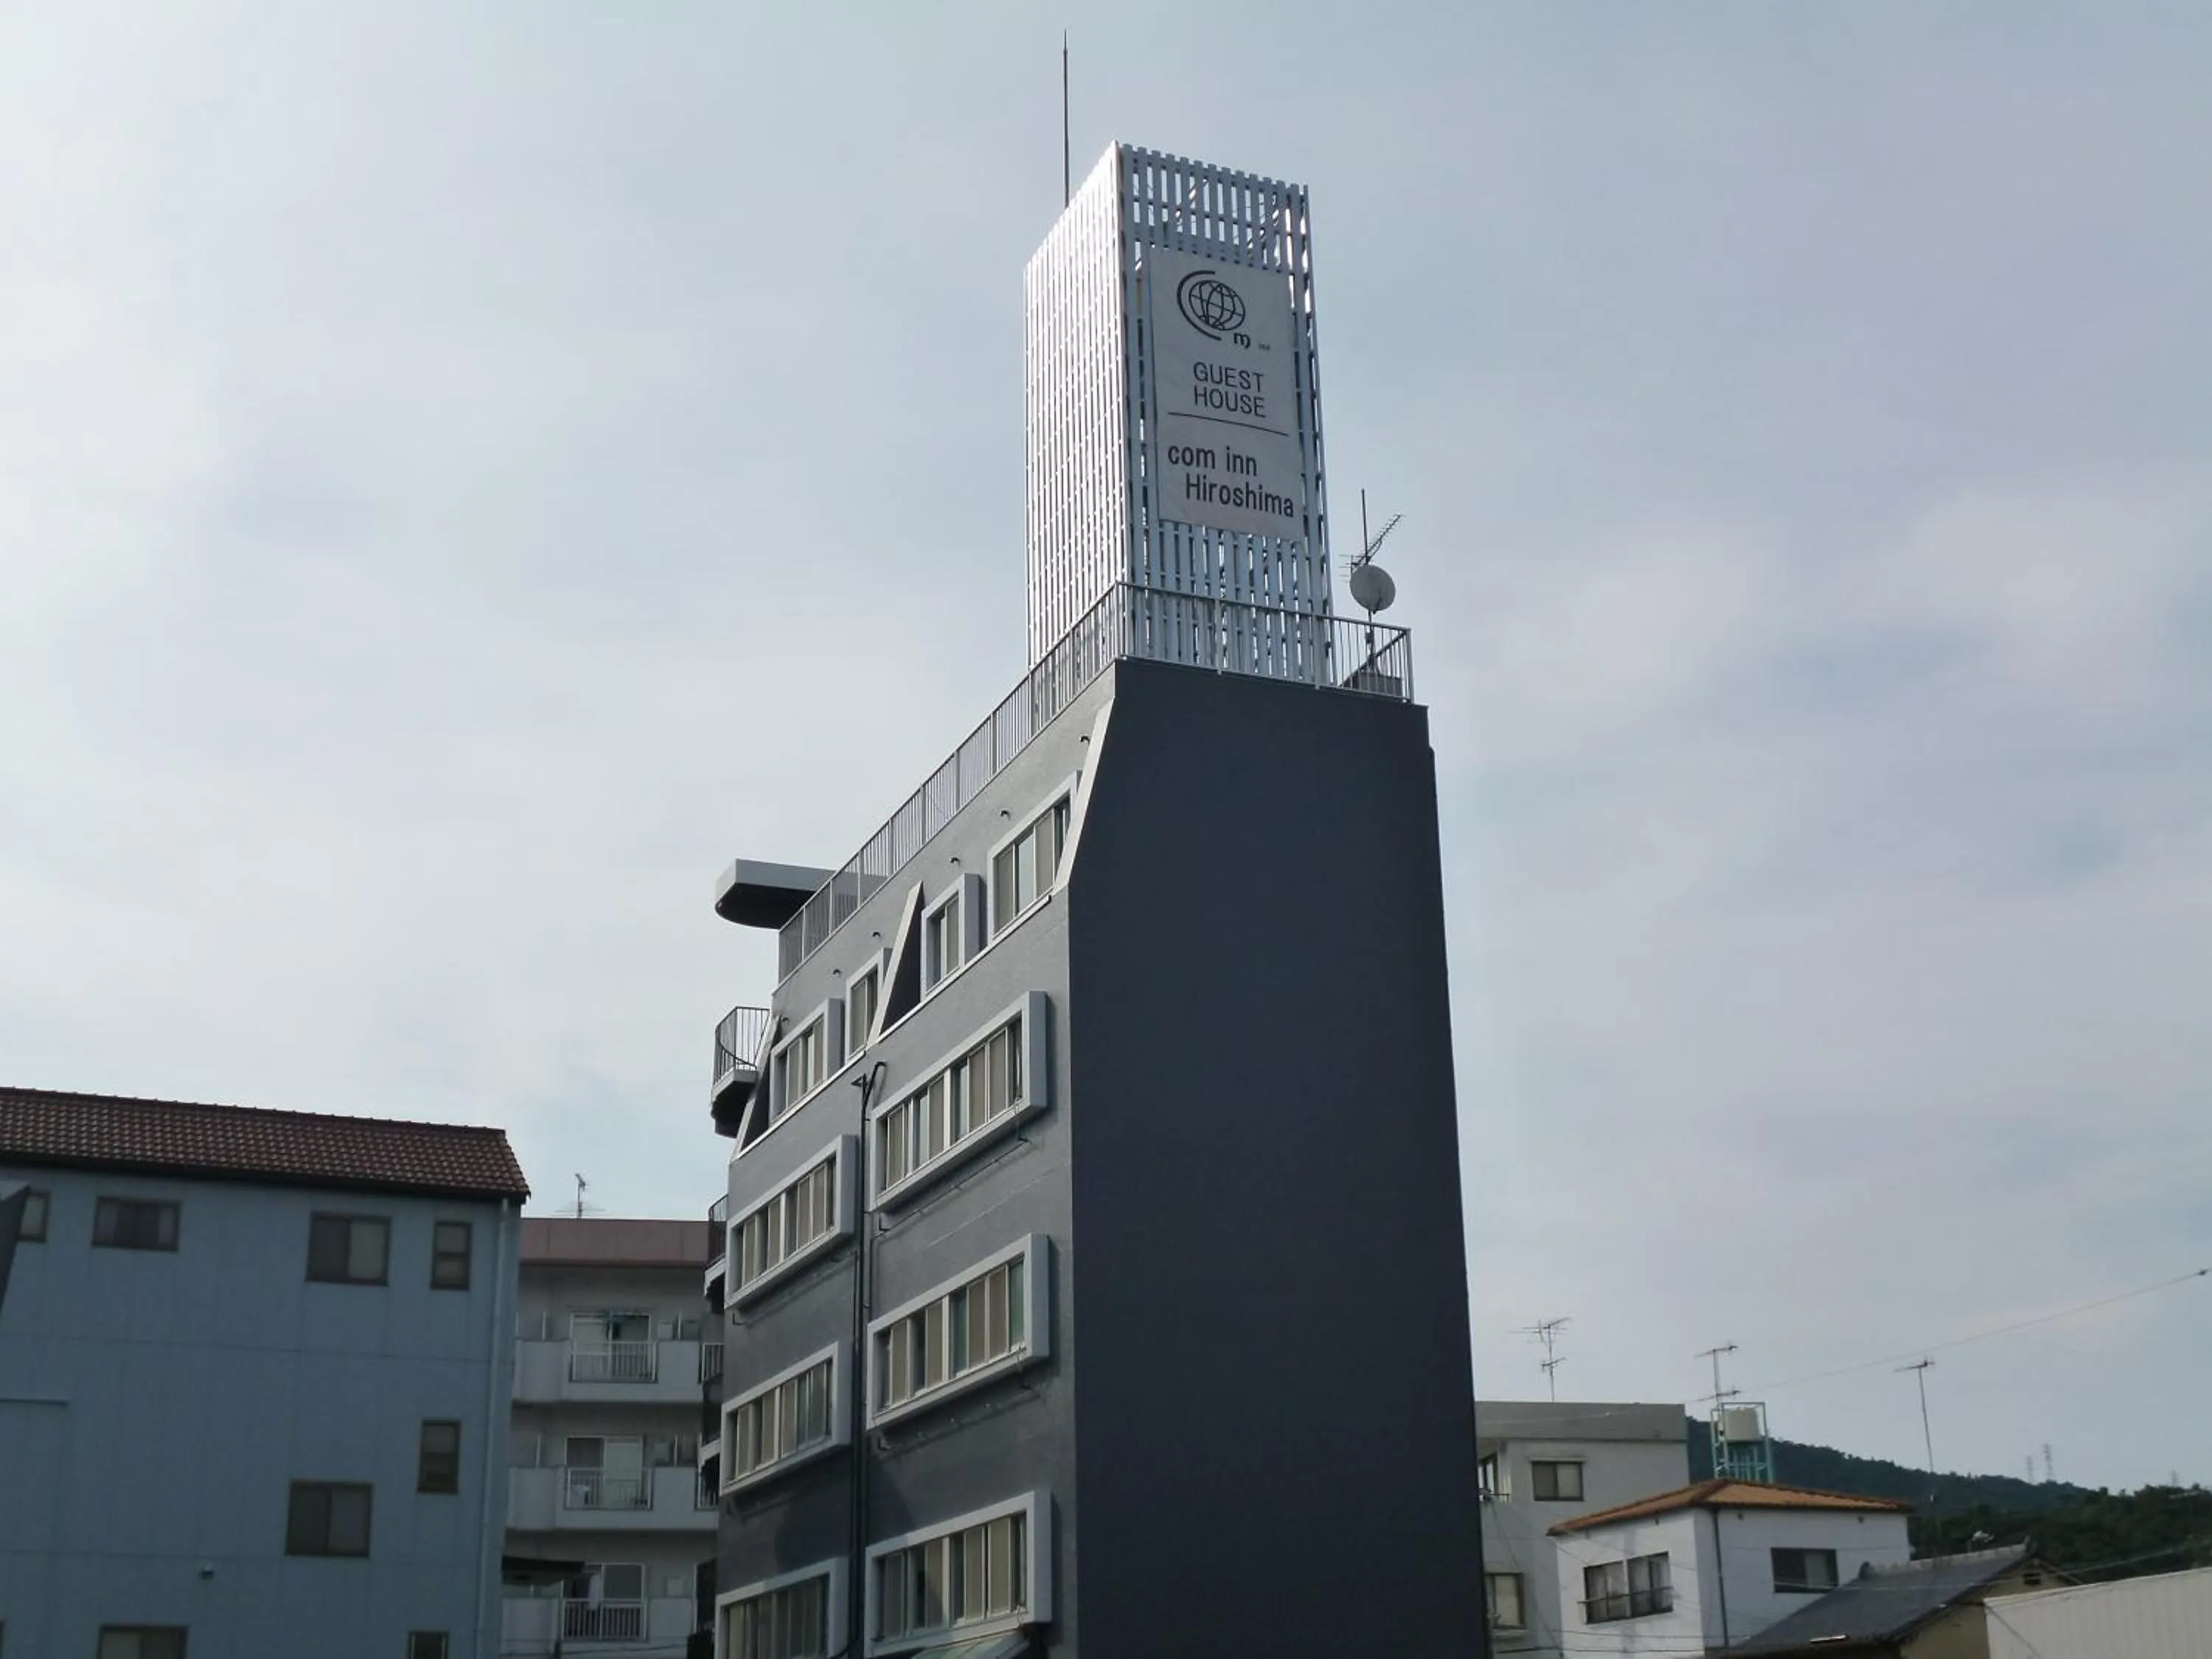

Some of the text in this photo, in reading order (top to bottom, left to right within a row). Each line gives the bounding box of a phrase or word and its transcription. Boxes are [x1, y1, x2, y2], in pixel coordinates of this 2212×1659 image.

[1193, 361, 1264, 392] GUEST
[1194, 385, 1266, 418] HOUSE
[1167, 445, 1257, 476] com inn
[1186, 473, 1294, 518] Hiroshima
